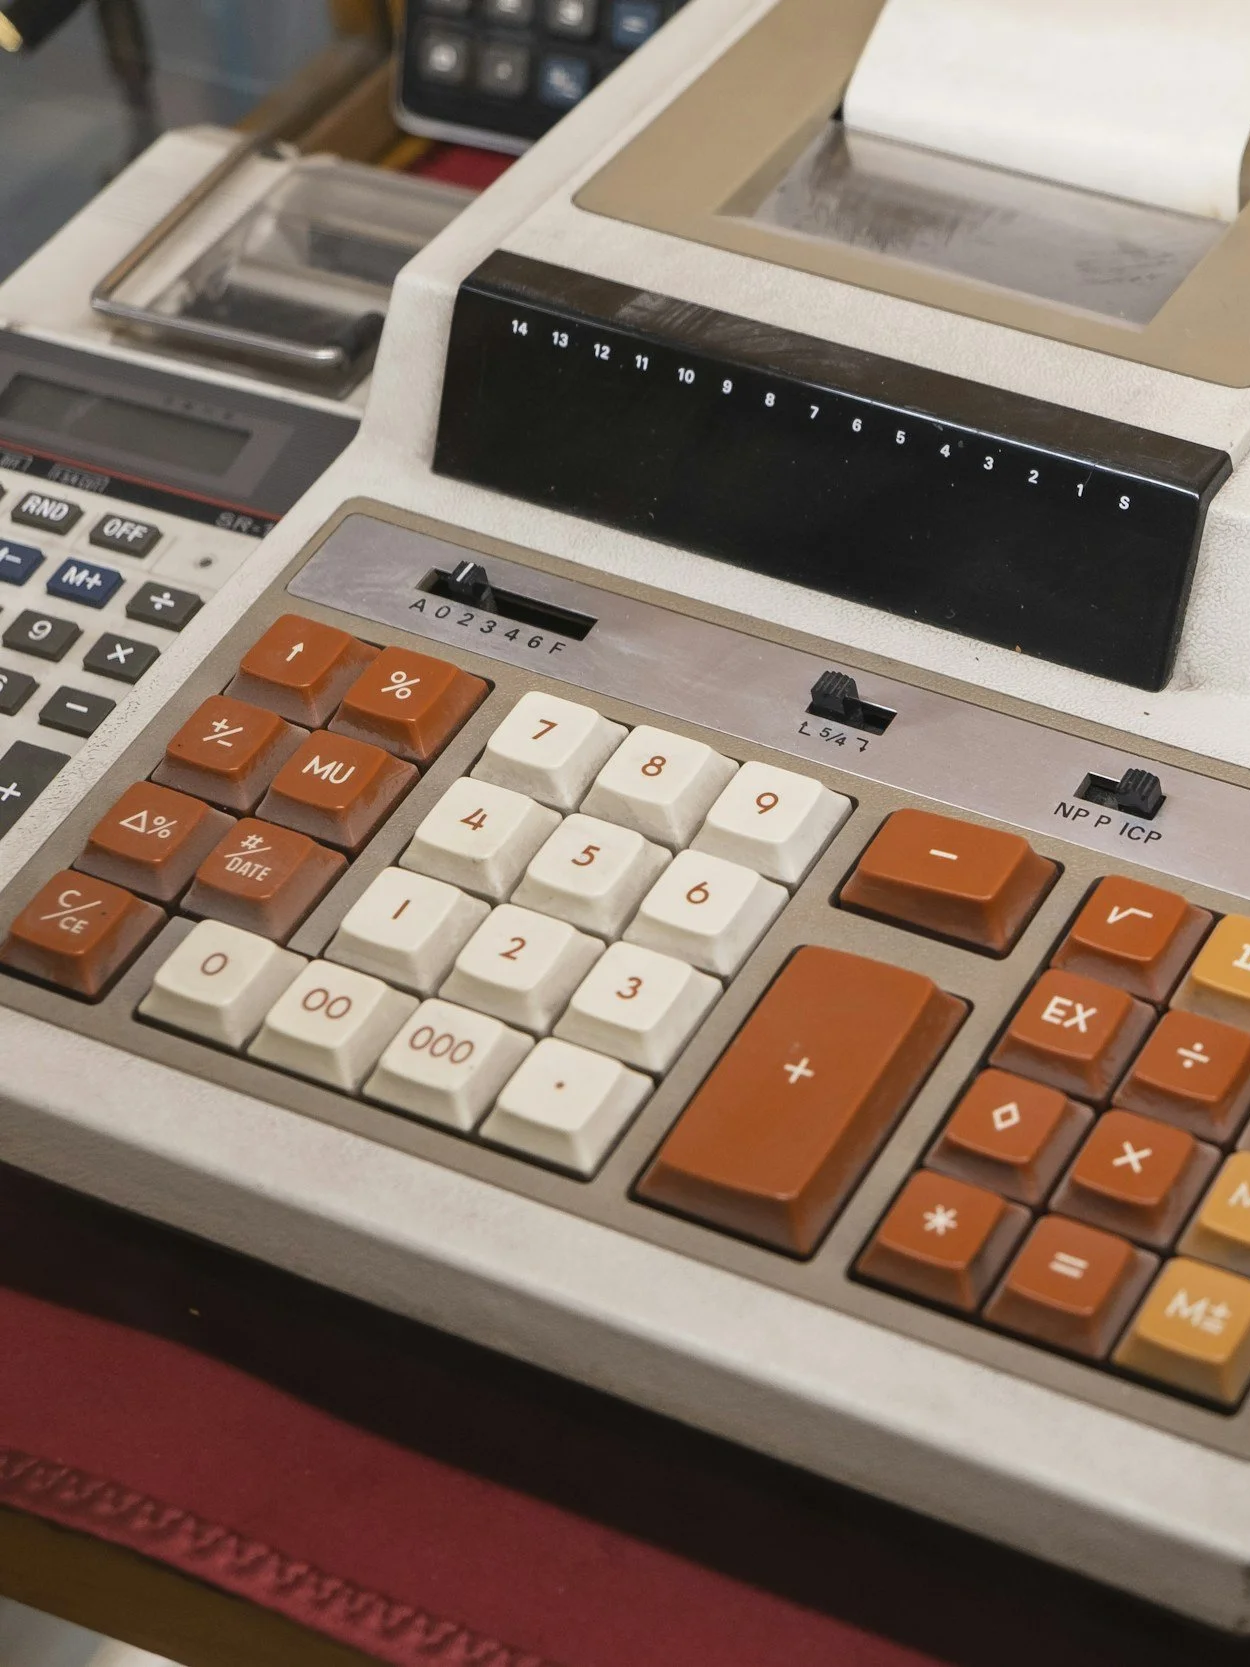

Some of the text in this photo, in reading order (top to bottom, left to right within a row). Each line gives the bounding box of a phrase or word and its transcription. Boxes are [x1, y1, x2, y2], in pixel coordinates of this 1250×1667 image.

[511, 319, 1131, 510] 14 13 12 11 10 9 8 7 6 5 4 3 2 1 S
[21, 494, 69, 521] RND
[103, 517, 149, 541] OFF
[62, 566, 102, 590] M+
[27, 619, 53, 641] 9
[408, 598, 427, 613] A
[456, 612, 475, 627] 2
[479, 619, 497, 634] 3
[503, 628, 521, 642] 4
[527, 635, 544, 649] 6
[548, 641, 567, 654] F
[380, 670, 421, 700] %
[531, 718, 559, 740] 7
[819, 726, 848, 747] 5/4
[301, 754, 356, 784] MU
[641, 755, 667, 777] 8
[755, 791, 779, 815] 9
[460, 807, 488, 831] 4
[1053, 801, 1163, 844] NP P ICP
[571, 844, 601, 867] 5
[685, 881, 710, 905] 6
[392, 899, 411, 920] 1
[499, 936, 527, 961] 2
[200, 952, 229, 977] 0
[615, 976, 643, 1000] 3
[301, 987, 353, 1020] 00
[1041, 995, 1098, 1033] EX
[408, 1025, 475, 1065] 000
